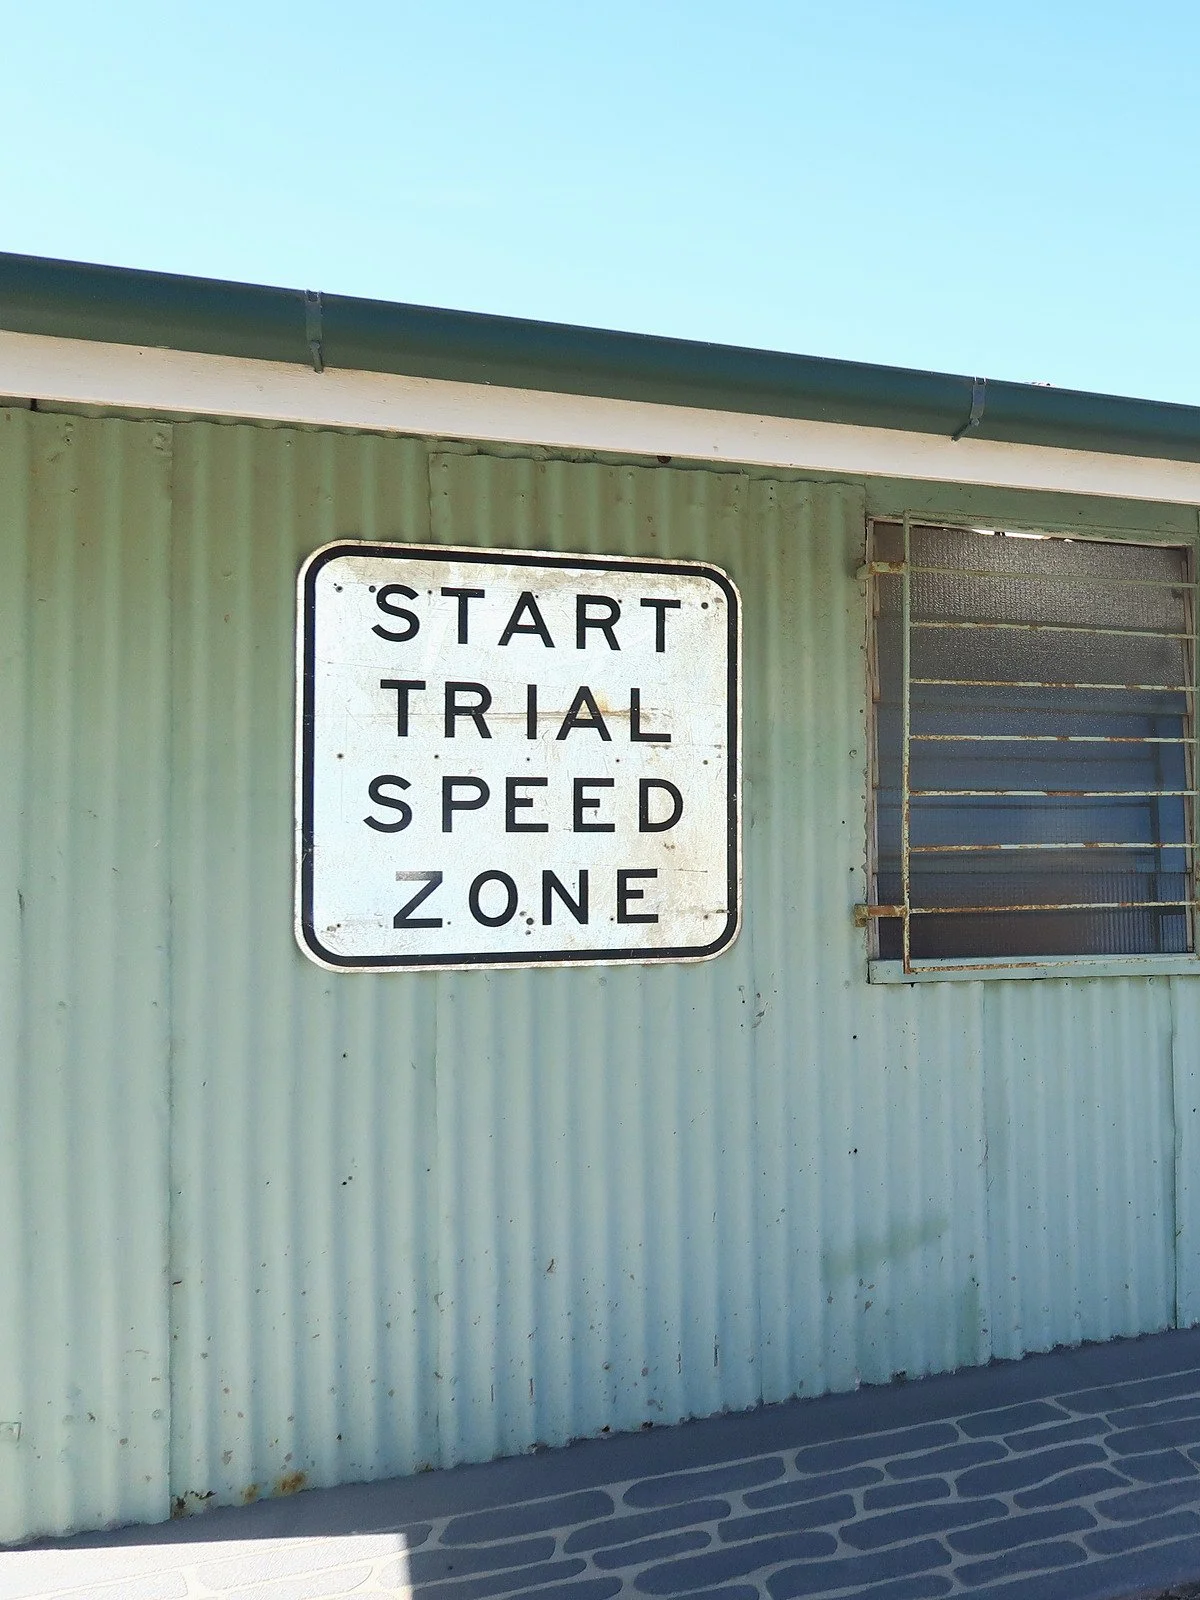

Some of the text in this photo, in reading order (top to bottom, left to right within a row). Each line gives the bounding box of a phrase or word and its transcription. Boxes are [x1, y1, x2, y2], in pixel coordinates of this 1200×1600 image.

[372, 584, 681, 652] START
[380, 679, 672, 743] TRIAL
[363, 775, 684, 833] SPEED
[393, 869, 659, 929] ZONE
